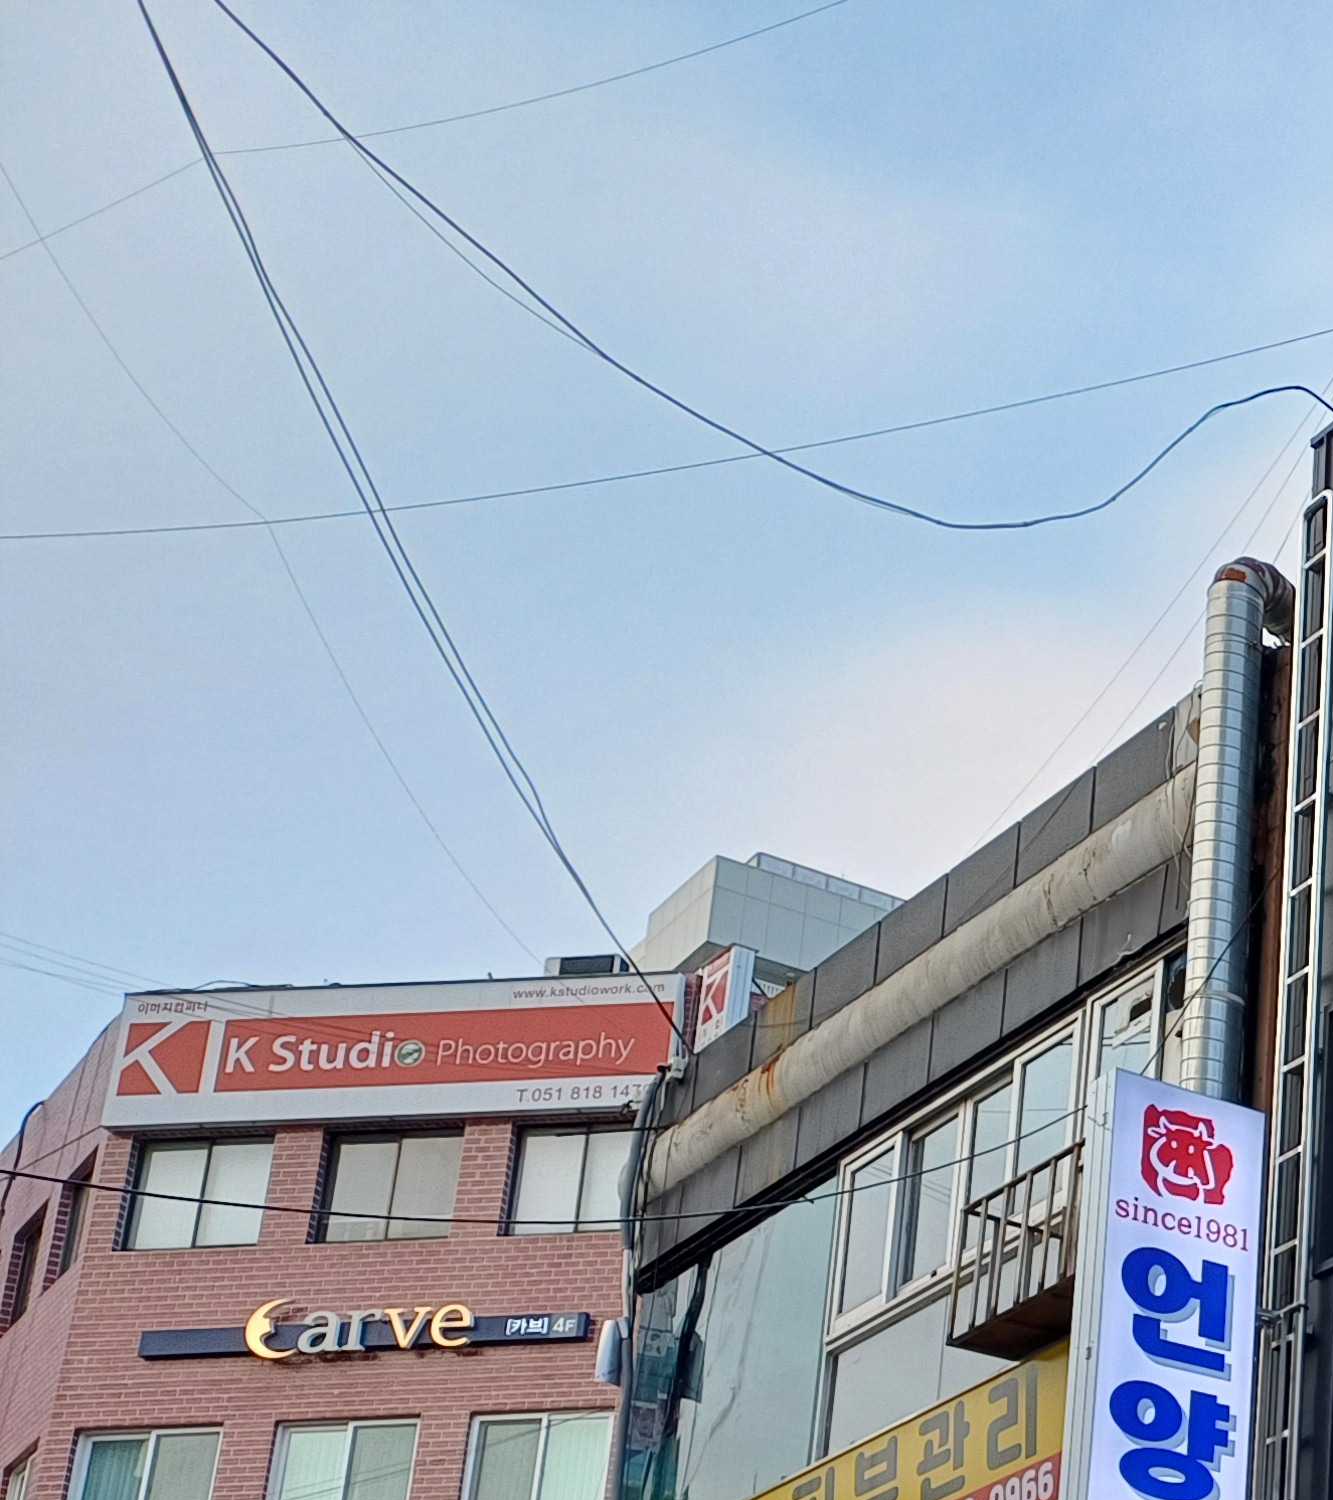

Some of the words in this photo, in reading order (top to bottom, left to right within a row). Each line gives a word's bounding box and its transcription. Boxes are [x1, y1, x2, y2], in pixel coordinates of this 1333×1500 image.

[225, 1037, 259, 1073] K
[436, 1032, 635, 1068] Photography
[570, 1085, 602, 1100] 818
[1115, 1197, 1249, 1252] since1981
[245, 1298, 474, 1360] Carve
[552, 1317, 576, 1333] 4F
